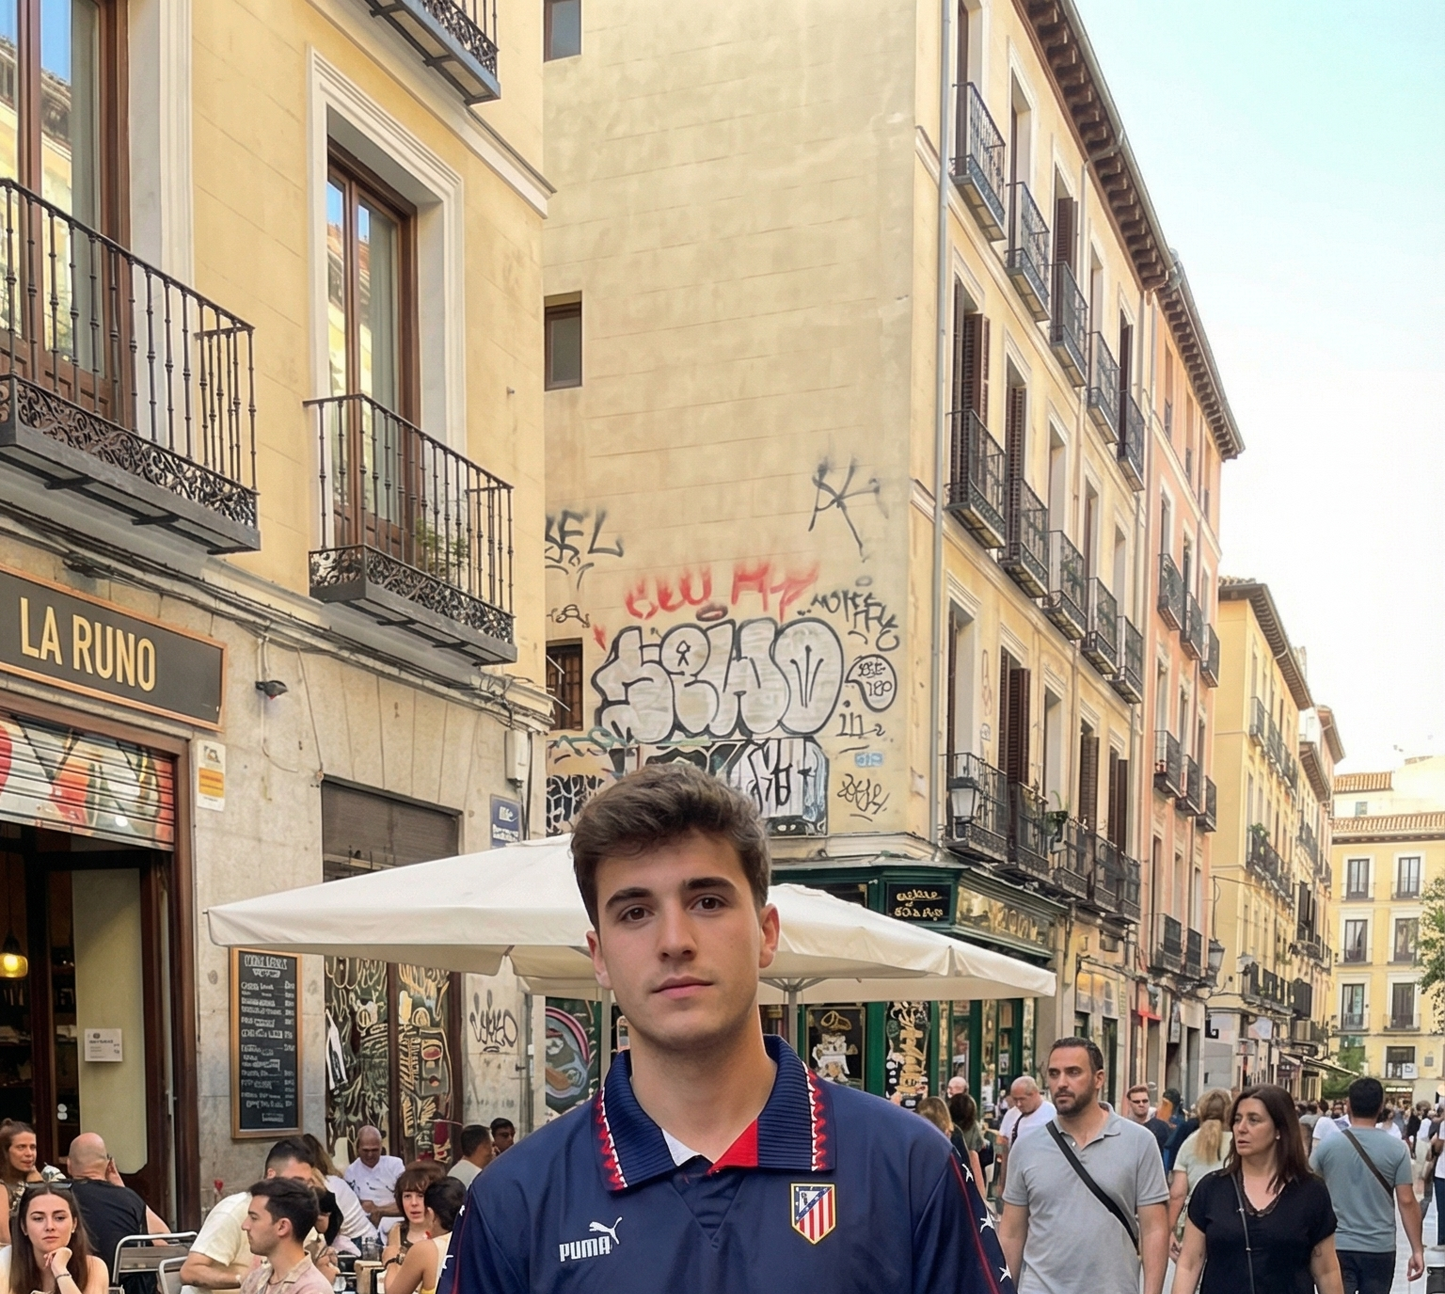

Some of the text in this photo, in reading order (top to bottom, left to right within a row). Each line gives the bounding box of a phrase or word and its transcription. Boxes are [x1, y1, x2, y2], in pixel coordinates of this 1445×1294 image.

[20, 596, 156, 692] LA RUNO
[559, 1235, 611, 1263] PUMA
